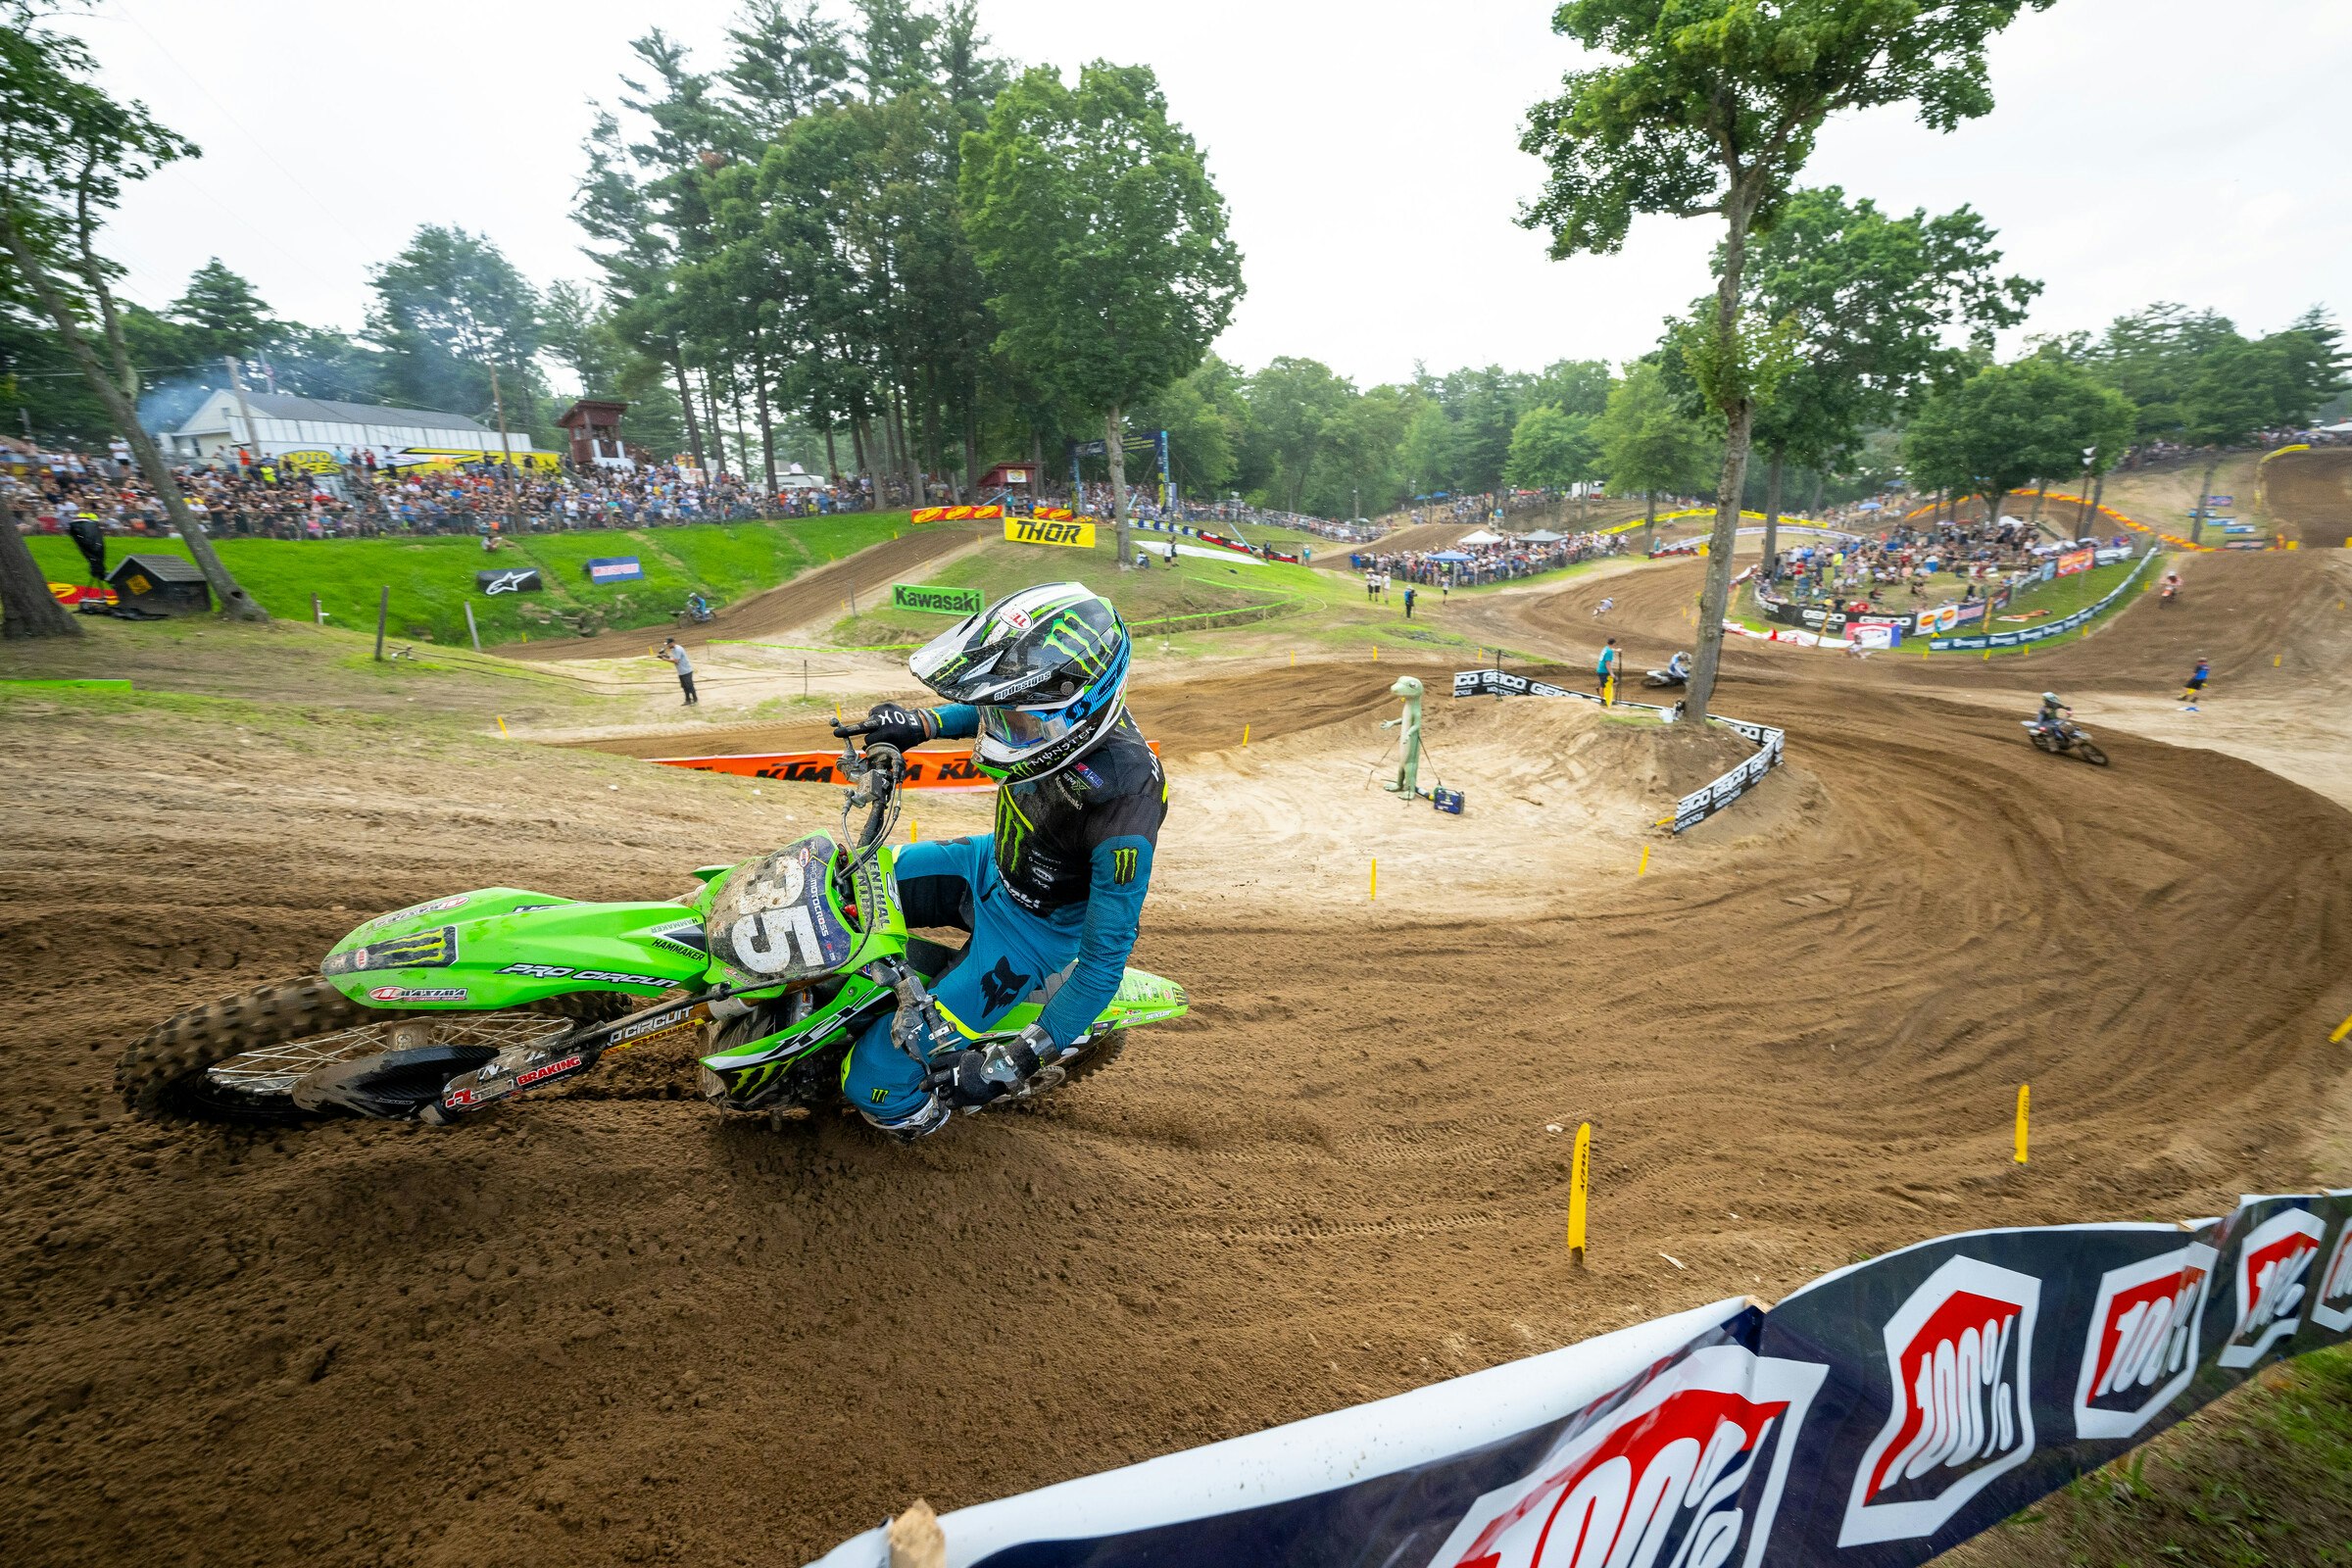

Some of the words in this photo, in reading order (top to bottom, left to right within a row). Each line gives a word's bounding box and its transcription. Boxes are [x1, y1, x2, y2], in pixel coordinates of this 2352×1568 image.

[1016, 520, 1082, 544] THOR
[896, 587, 980, 612] Kawasaki
[1802, 609, 1846, 622] GEICO
[1859, 614, 1911, 626] GEICO
[994, 670, 1052, 701] apdesigns
[1482, 672, 1526, 690] GEICO
[878, 710, 918, 725] FOX
[1031, 725, 1096, 765] MONSTER
[754, 760, 834, 782] KTM
[1713, 765, 1748, 799] GEICO
[1055, 775, 1083, 810] Kawasaki
[732, 855, 824, 973] 35
[652, 939, 705, 961] HAMMAKER
[501, 964, 574, 978] PRO
[572, 970, 680, 987] CIRCUIT
[625, 1005, 694, 1038] CIRCUIT
[516, 1056, 582, 1086] BRAKING
[2095, 1278, 2203, 1396] 100%
[1879, 1314, 2014, 1491] 100%
[1536, 1417, 1775, 1568] 00%
